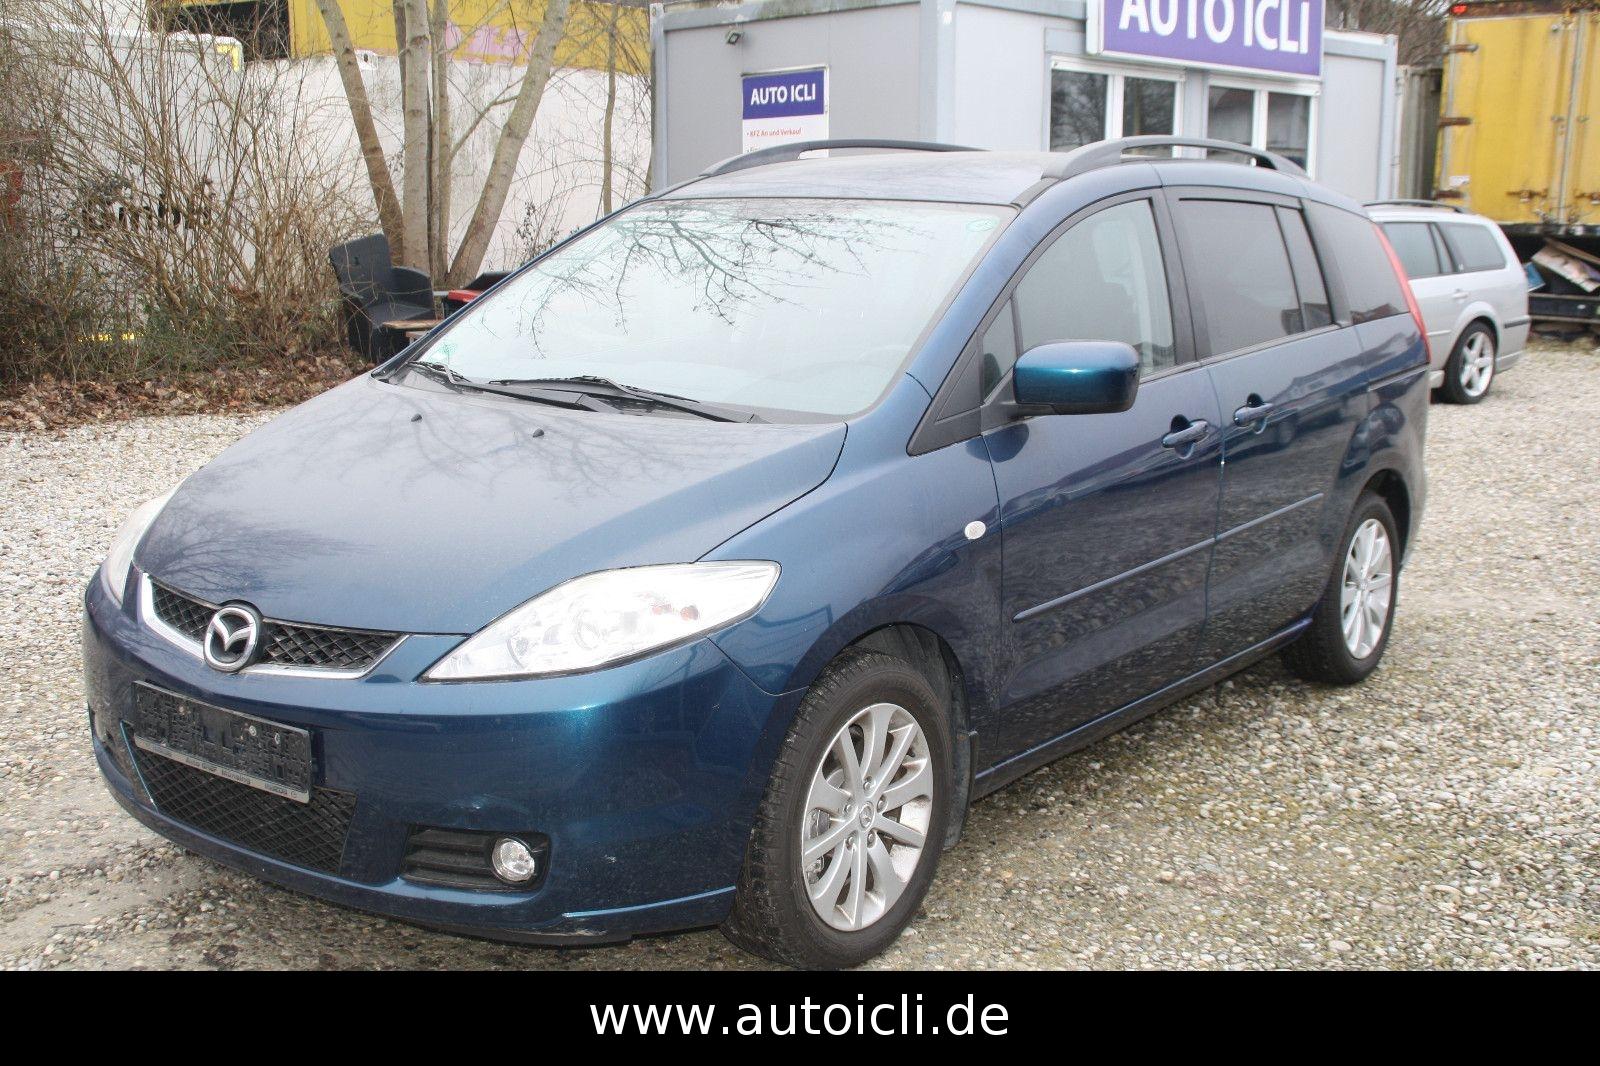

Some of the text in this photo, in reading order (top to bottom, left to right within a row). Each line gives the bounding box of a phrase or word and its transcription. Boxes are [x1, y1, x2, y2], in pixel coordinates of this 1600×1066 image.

[1118, 0, 1310, 54] AUTO ICLI
[750, 83, 816, 106] AUTO ICLI
